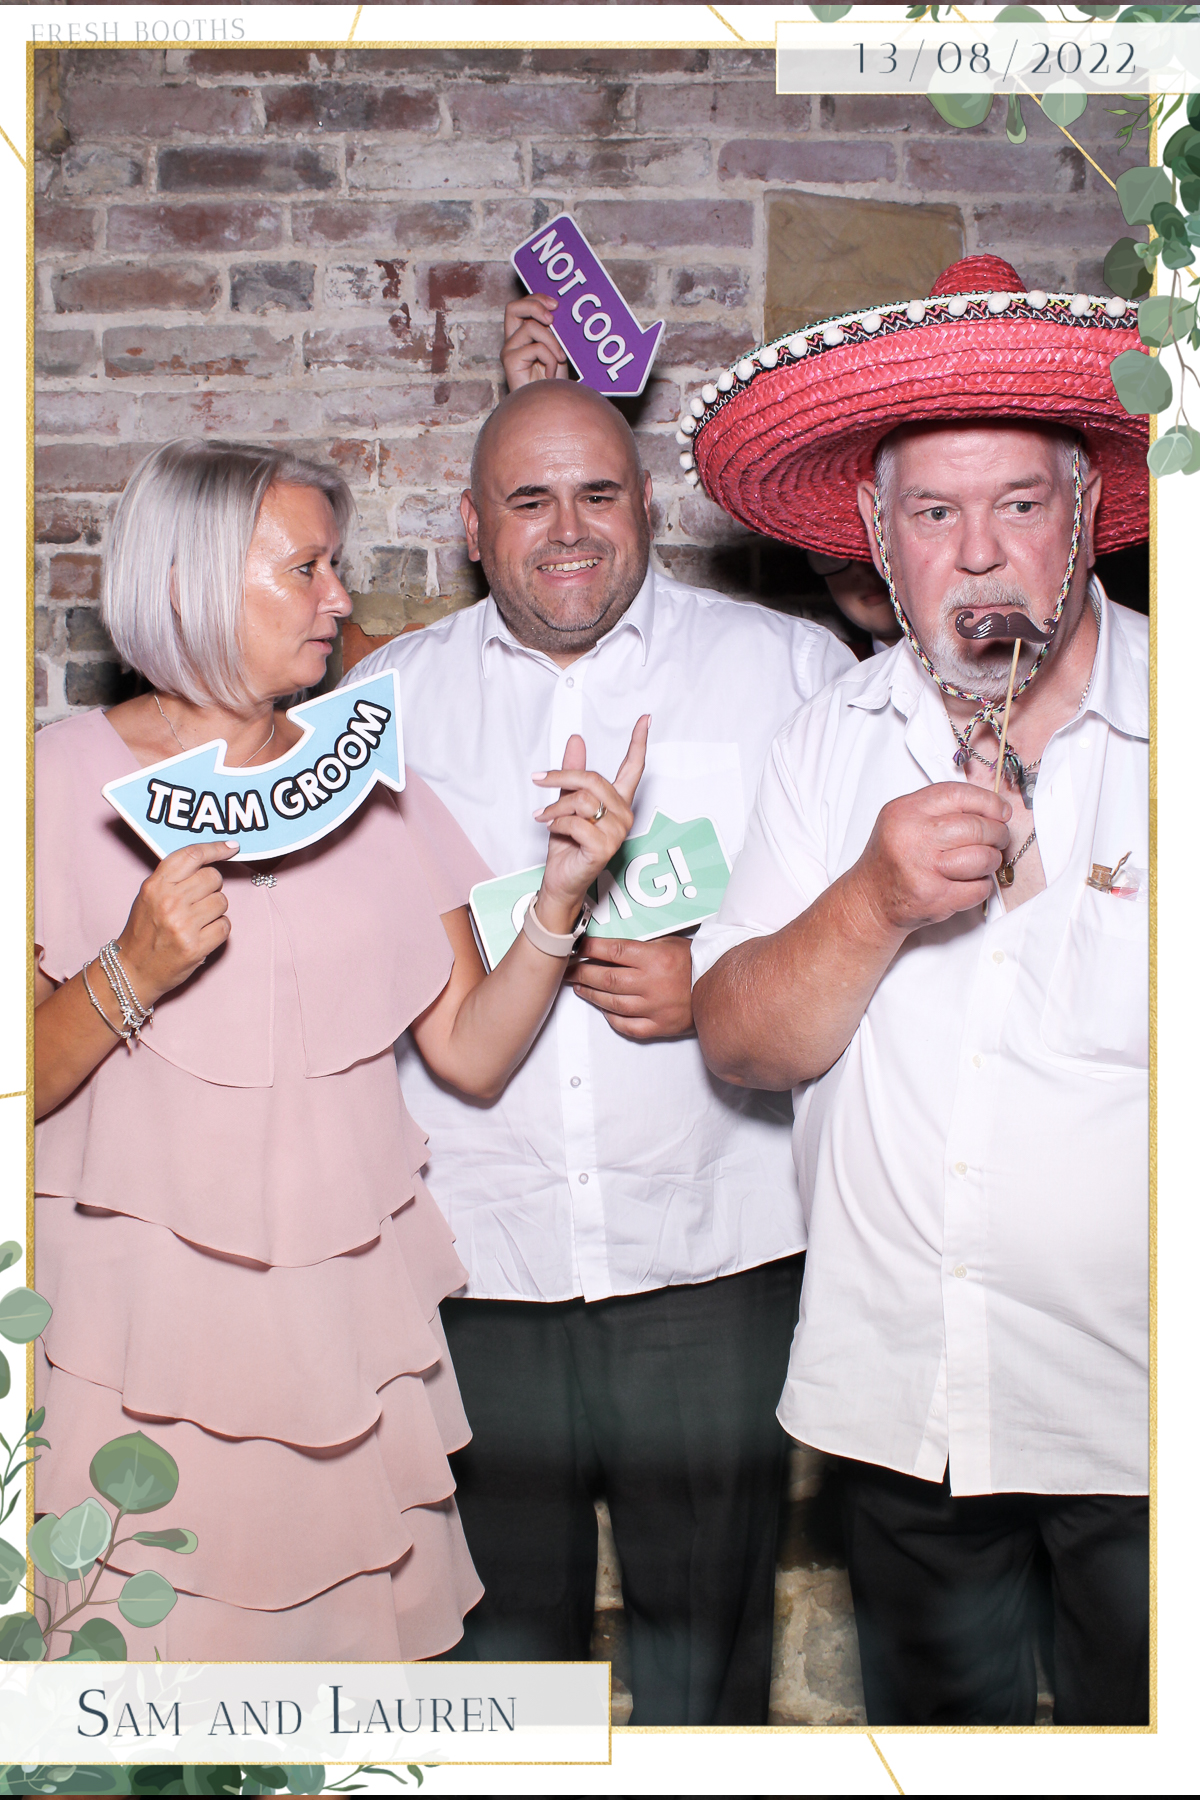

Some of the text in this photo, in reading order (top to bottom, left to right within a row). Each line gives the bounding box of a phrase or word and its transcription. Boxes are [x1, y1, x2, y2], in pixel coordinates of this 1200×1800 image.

[531, 229, 635, 382] NOT COOL
[147, 701, 391, 833] TEAM GROOM
